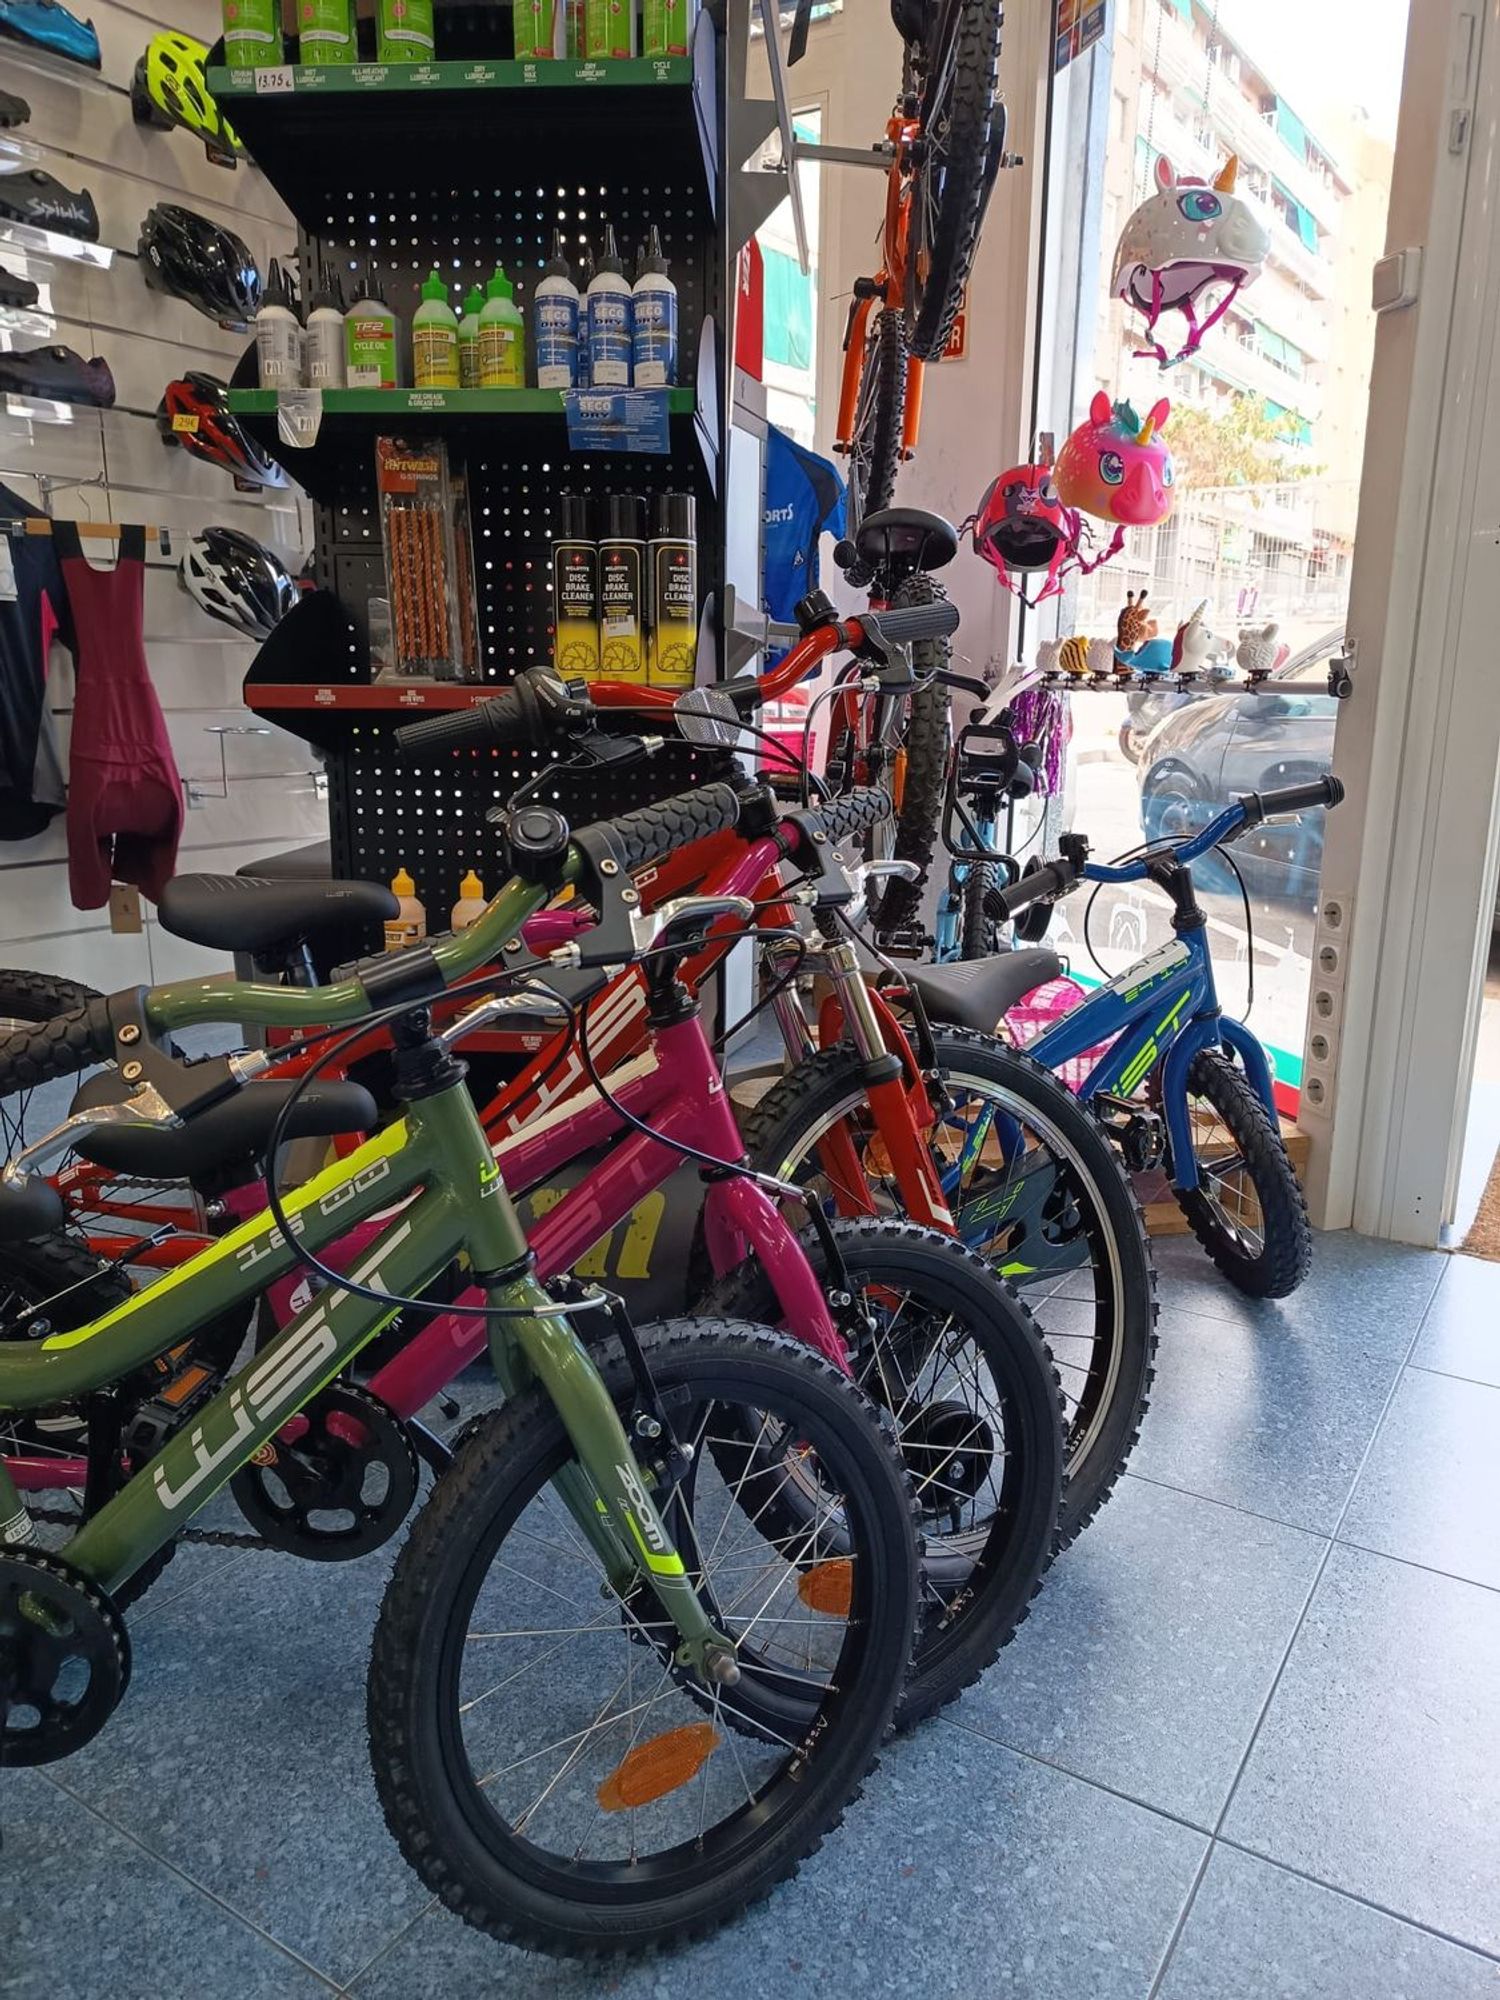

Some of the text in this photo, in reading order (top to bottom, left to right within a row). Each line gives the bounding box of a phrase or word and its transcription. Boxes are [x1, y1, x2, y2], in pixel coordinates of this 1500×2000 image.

[26, 198, 90, 223] Spiuk
[540, 310, 571, 321] SECO
[594, 308, 626, 320] SECO
[635, 306, 663, 318] SECO
[594, 318, 623, 326] DRY
[635, 317, 660, 325] DRY
[354, 321, 384, 332] TF2
[353, 341, 374, 351] CYCLE
[579, 400, 611, 411] SECO
[580, 411, 610, 419] DRY
[569, 574, 587, 582] DISC
[607, 574, 625, 582] DISC
[672, 574, 690, 583] DISC
[565, 583, 591, 592] BRAKE
[605, 583, 629, 591] BRAKE
[668, 583, 692, 592] BRAKE
[561, 592, 594, 601] CLEANER
[602, 592, 633, 601] CLEANER
[664, 592, 694, 601] CLEANER
[614, 1462, 665, 1551] zoom
